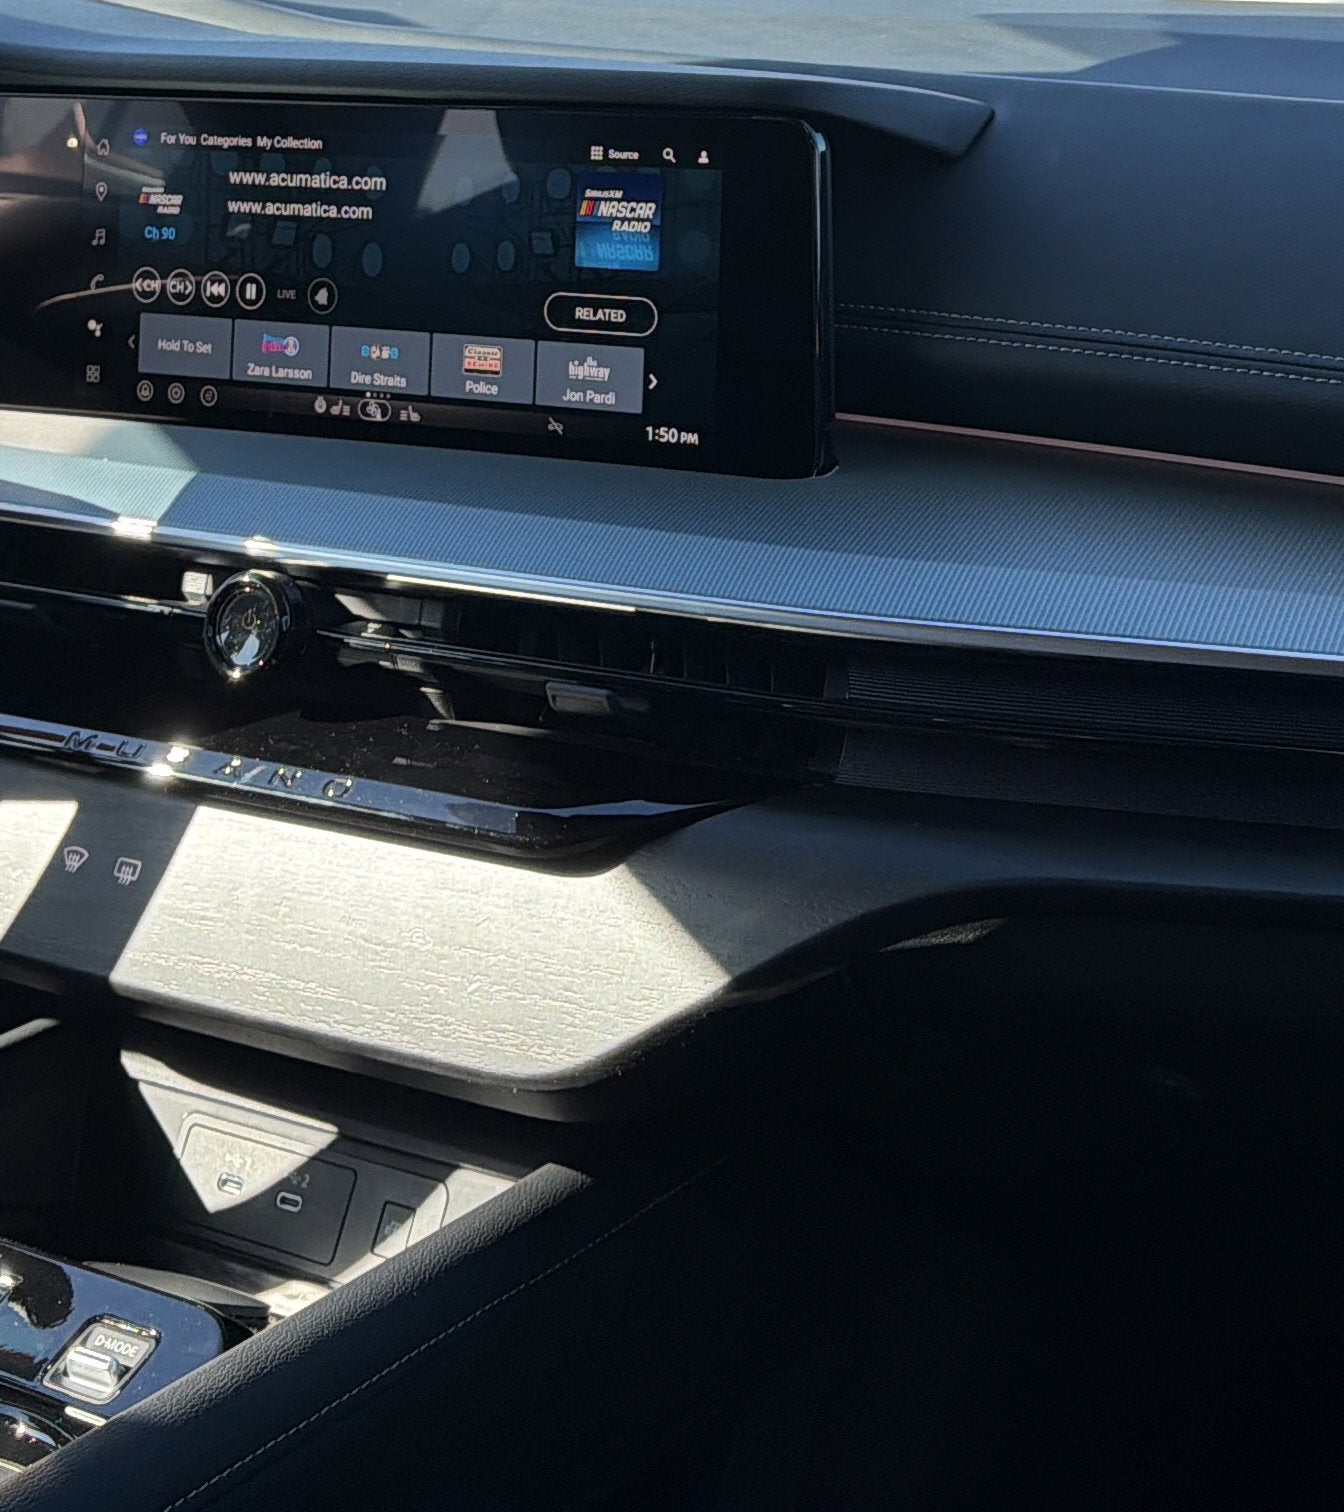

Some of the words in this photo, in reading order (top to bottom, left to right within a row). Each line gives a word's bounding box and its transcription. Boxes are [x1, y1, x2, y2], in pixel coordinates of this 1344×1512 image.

[160, 132, 177, 144] For
[178, 133, 197, 145] You
[200, 134, 253, 148] Categories
[256, 136, 272, 150] My
[274, 136, 323, 150] Collection
[608, 149, 640, 160] Source
[228, 171, 387, 191] www.acumatica.com
[227, 200, 373, 220] www.acumatica.com
[597, 200, 656, 219] NASCAR
[144, 226, 159, 239] Ch
[161, 227, 176, 240] 90
[612, 220, 651, 233] RADIO
[277, 289, 297, 300] LIVE
[575, 306, 627, 323] RELATED
[157, 338, 181, 351] Hold
[183, 340, 194, 352] To
[195, 342, 212, 355] Set
[247, 363, 270, 376] Zara
[272, 365, 313, 380] Larsson
[350, 371, 371, 384] Dire
[372, 373, 407, 388] Straits
[568, 360, 610, 382] highway
[465, 380, 499, 396] Police
[562, 389, 583, 403] Jon
[585, 389, 616, 406] Pardi
[644, 425, 679, 444] 1:50
[680, 431, 699, 446] PM
[63, 730, 353, 799] MUANO
